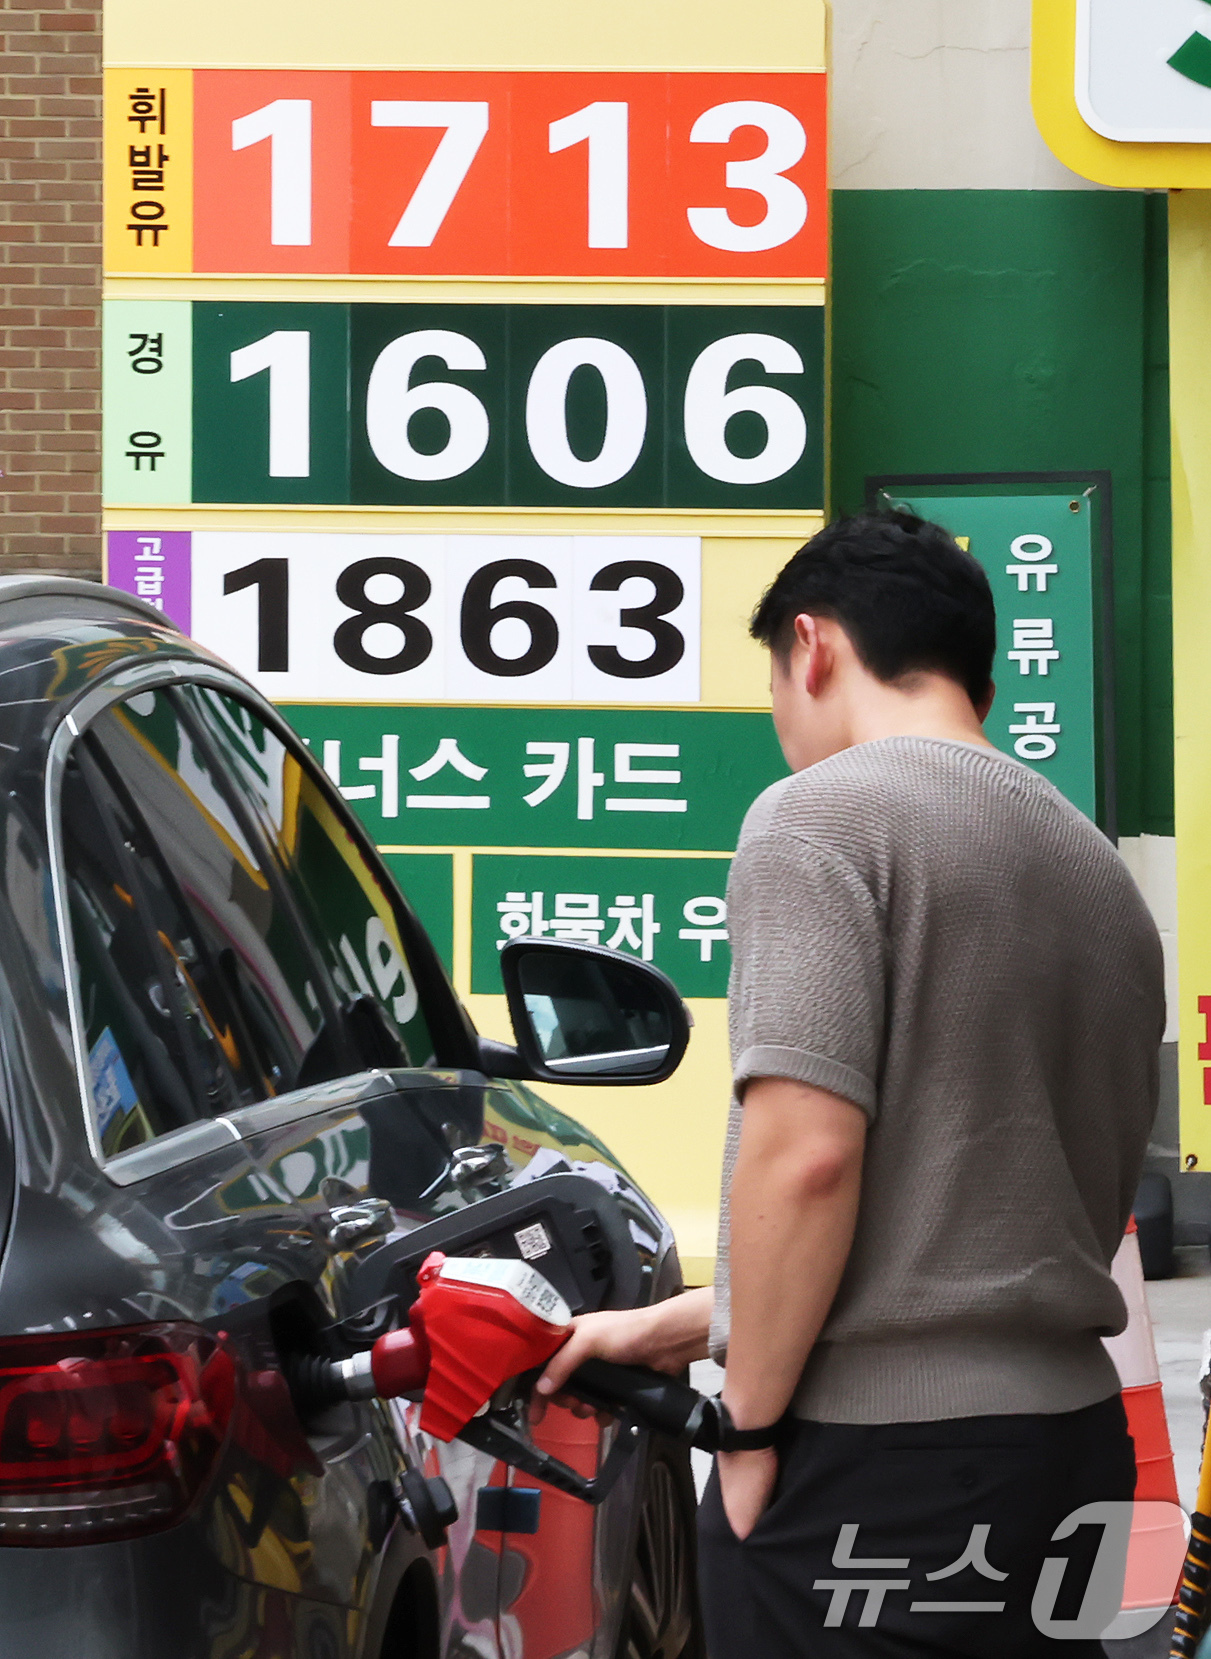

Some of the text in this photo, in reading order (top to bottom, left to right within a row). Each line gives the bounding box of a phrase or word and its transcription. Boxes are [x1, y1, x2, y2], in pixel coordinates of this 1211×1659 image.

[127, 88, 168, 247] 휘발유
[232, 99, 808, 253] 1713
[126, 332, 166, 472] 경유
[230, 329, 808, 489] 1606
[223, 556, 686, 679] 1863
[302, 734, 688, 820] 너스 카드
[497, 891, 661, 961] 화물차
